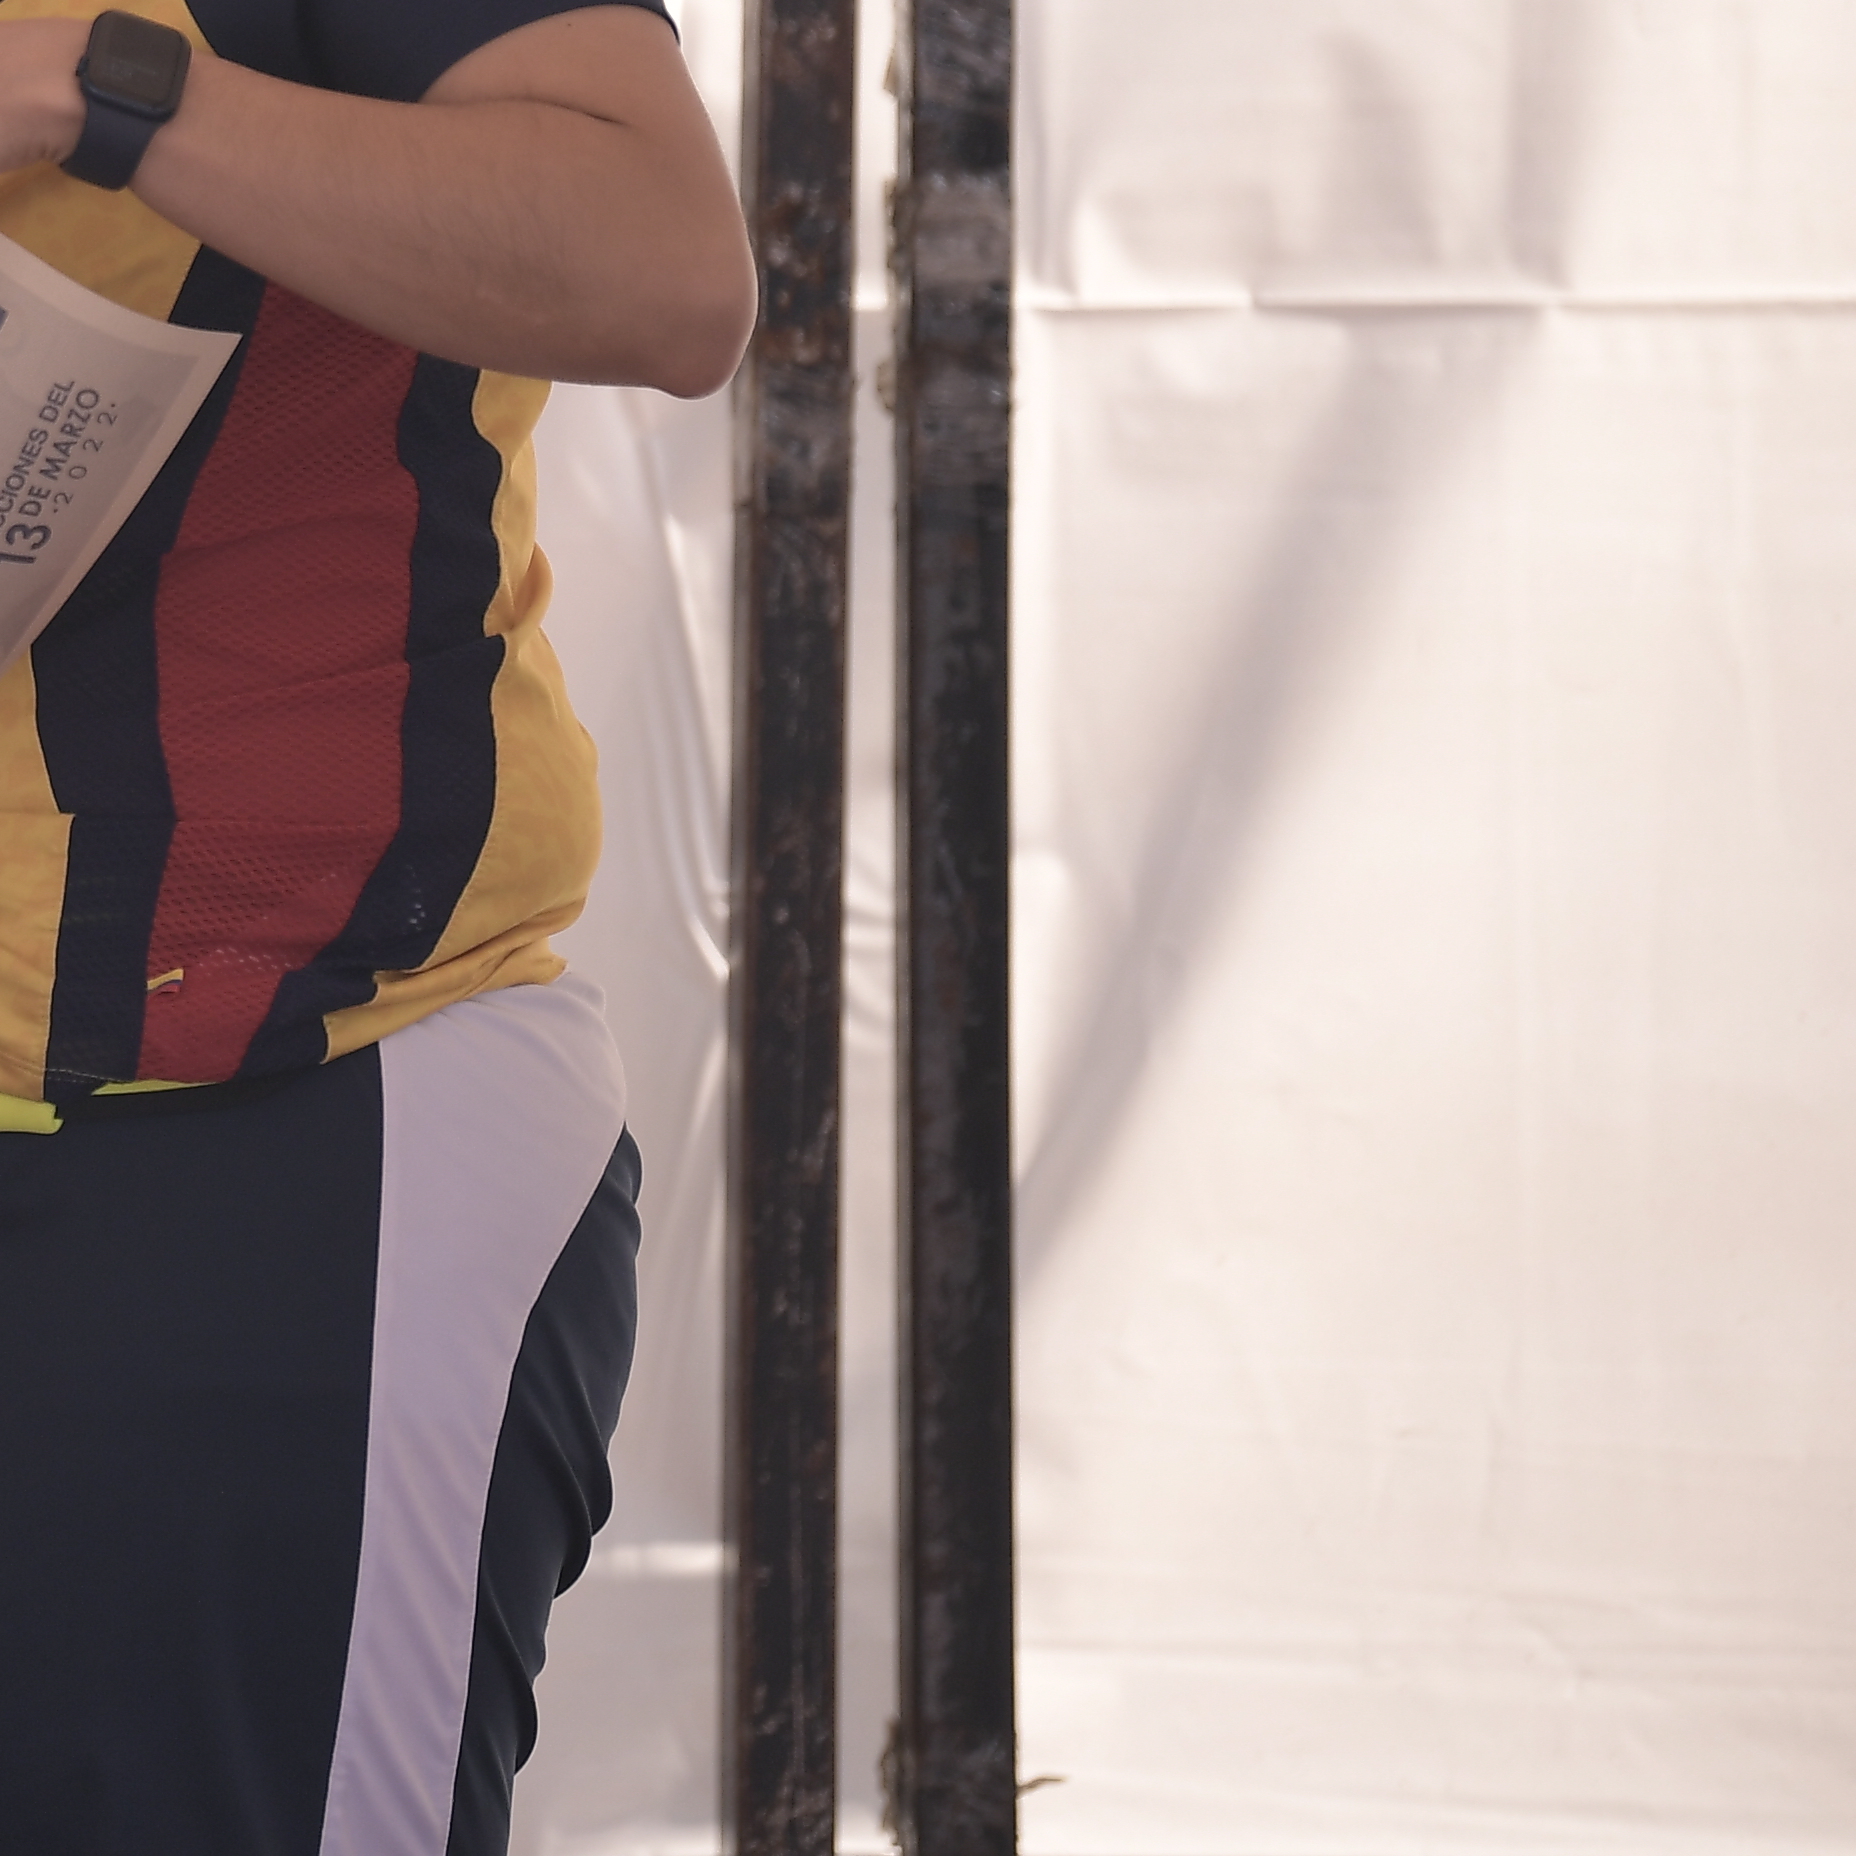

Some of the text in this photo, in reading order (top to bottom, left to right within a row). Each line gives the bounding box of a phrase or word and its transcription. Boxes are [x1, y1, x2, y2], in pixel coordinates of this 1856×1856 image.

[37, 373, 76, 425] DEL
[17, 481, 51, 521] DE
[37, 384, 102, 483] MARZO
